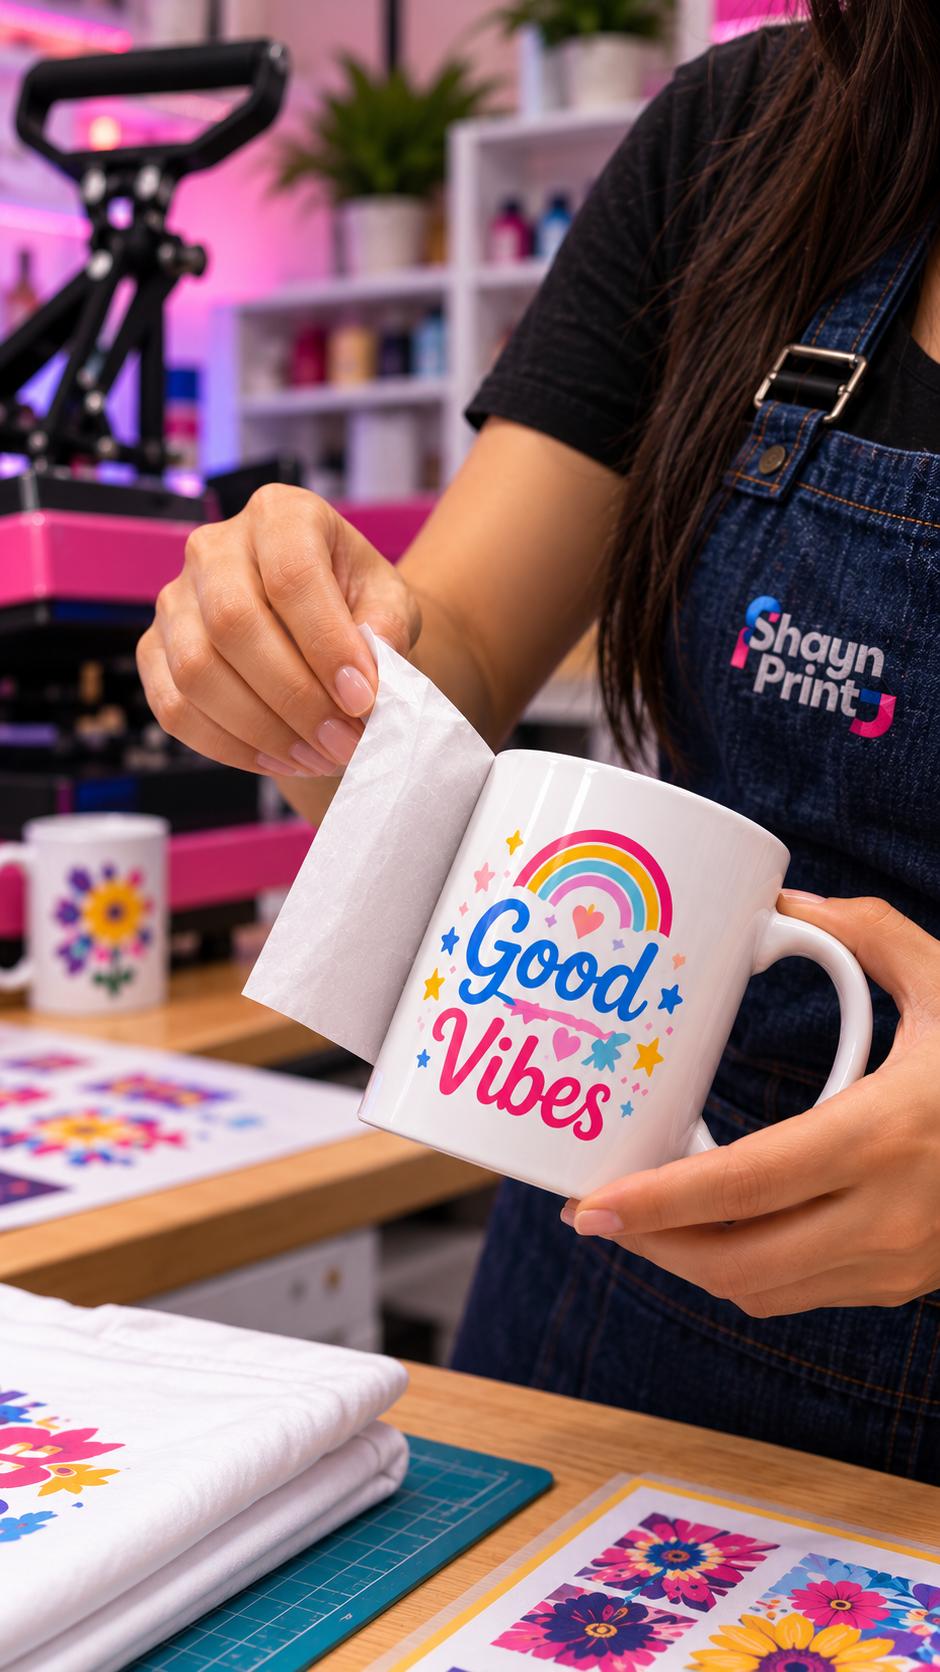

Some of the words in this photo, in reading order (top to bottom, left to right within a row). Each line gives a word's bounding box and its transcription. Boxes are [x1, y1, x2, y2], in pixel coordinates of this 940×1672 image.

[745, 596, 885, 680] Shayn
[753, 653, 861, 718] Print
[458, 898, 659, 1022] Good
[432, 1007, 611, 1141] Vibes
